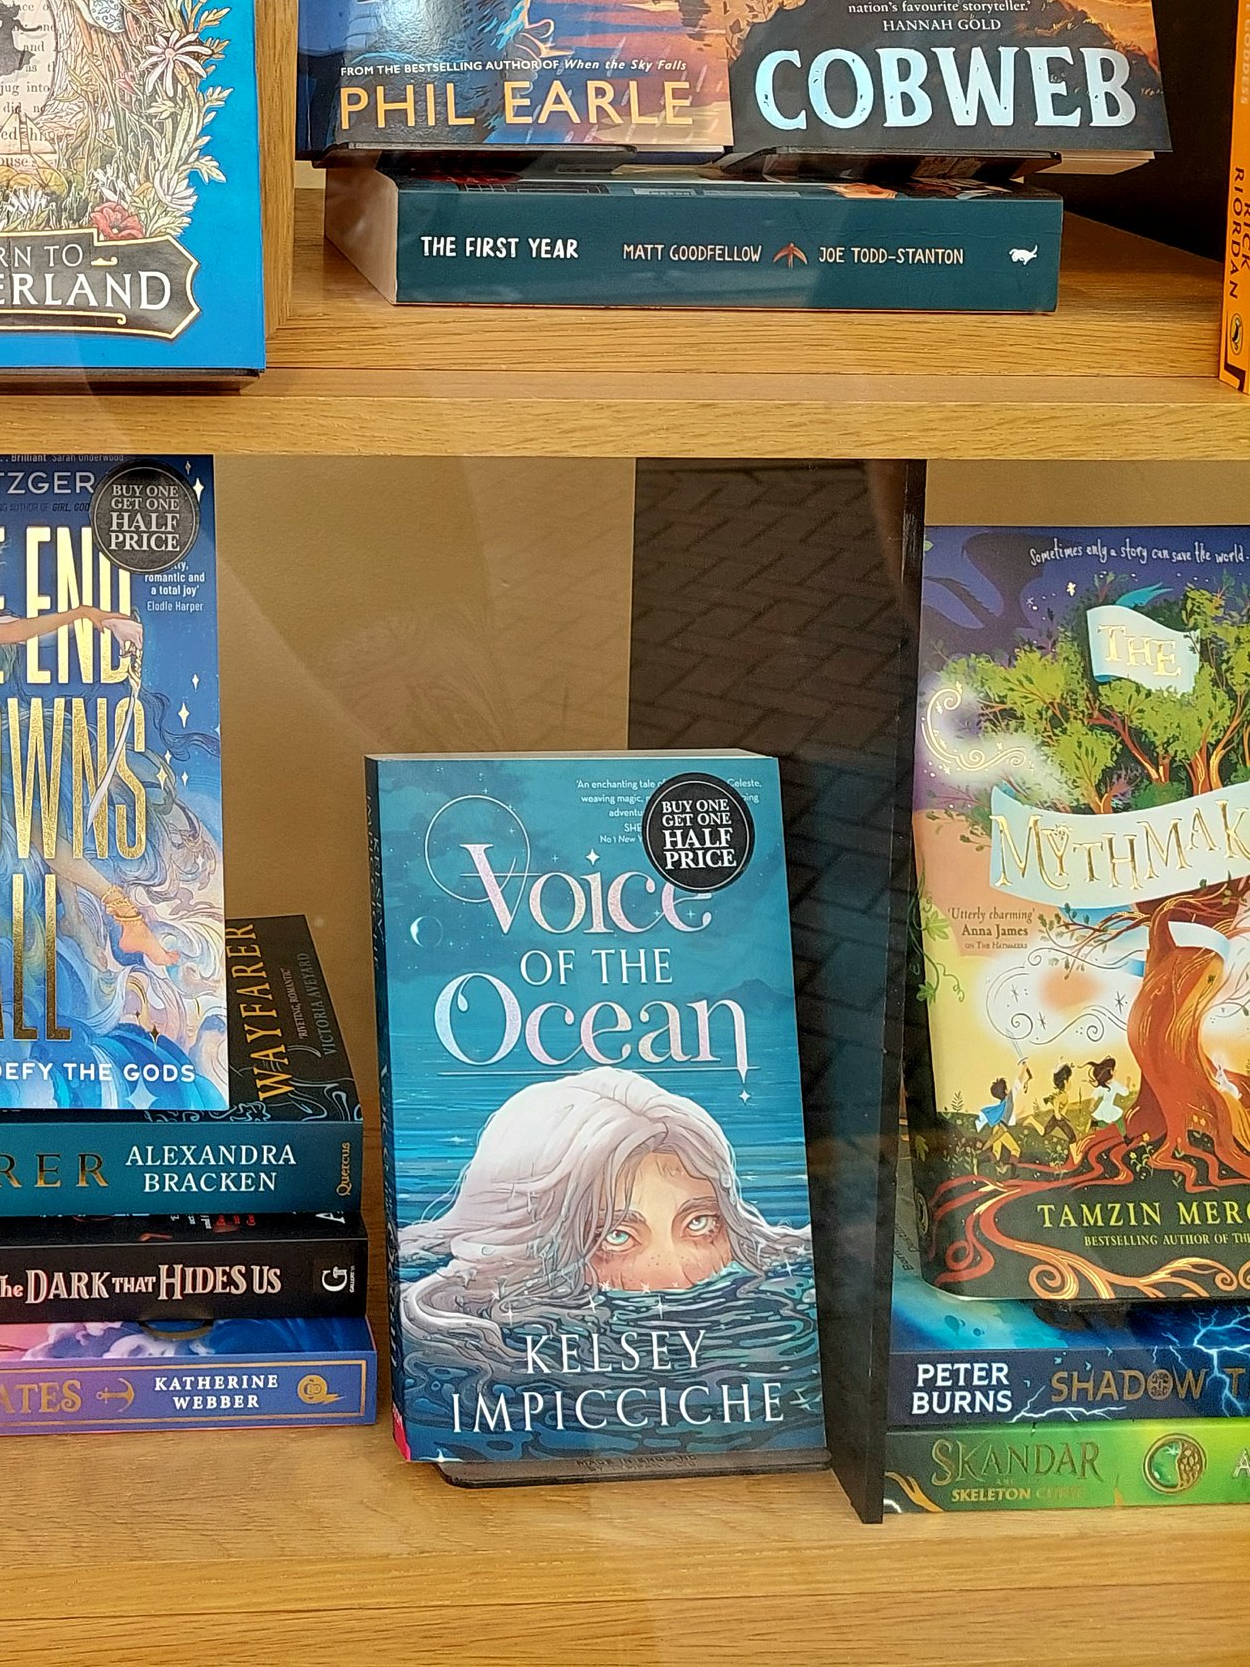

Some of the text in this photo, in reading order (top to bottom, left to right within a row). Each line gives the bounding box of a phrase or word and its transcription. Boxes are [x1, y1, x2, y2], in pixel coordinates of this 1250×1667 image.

[882, 18, 1001, 31] HANNAH GOLD
[341, 59, 686, 76] FROM THE BESTSELLING AUTHOR OF When the Sky Falls
[755, 46, 1138, 131] COBWEB
[340, 80, 693, 130] PHIL EARLE
[44, 243, 84, 267] TO
[421, 235, 964, 265] THE FIRST YEAR MATT GOODFELLOW JOE TODD-STANTON
[145, 572, 205, 582] romantic and
[27, 526, 133, 685] END
[147, 601, 203, 613] Elodie Harper
[662, 799, 730, 813] BUY ONE
[662, 812, 732, 827] GET ONE
[662, 827, 734, 850] HALF
[664, 849, 738, 870] PRICE
[455, 839, 713, 934] Voice
[961, 924, 1028, 939] Anna James
[520, 948, 673, 985] OF THE
[434, 972, 749, 1083] Ocean
[64, 1062, 112, 1082] THE
[123, 1063, 195, 1083] GODS
[125, 1144, 296, 1166] ALEXANDRA
[143, 1171, 278, 1194] BRACKEN
[1037, 1202, 1161, 1228] TAMZIN
[1084, 1233, 1229, 1246] BESTSELLING AUTHOR OF
[25, 1269, 110, 1304] DARK
[112, 1276, 156, 1294] THAT
[157, 1264, 248, 1300] HIDES
[251, 1268, 282, 1294] US
[525, 1330, 706, 1374] KELSEY
[154, 1374, 279, 1391] KATHERINE
[917, 1363, 1010, 1386] PETER
[1051, 1368, 1206, 1404] SHADOW
[173, 1393, 260, 1411] WEBBER
[452, 1383, 784, 1433] IMPICCICHE
[911, 1391, 1013, 1415] BURNS
[931, 1438, 1104, 1486] SKANDAR
[951, 1488, 1031, 1502] SKELETON
